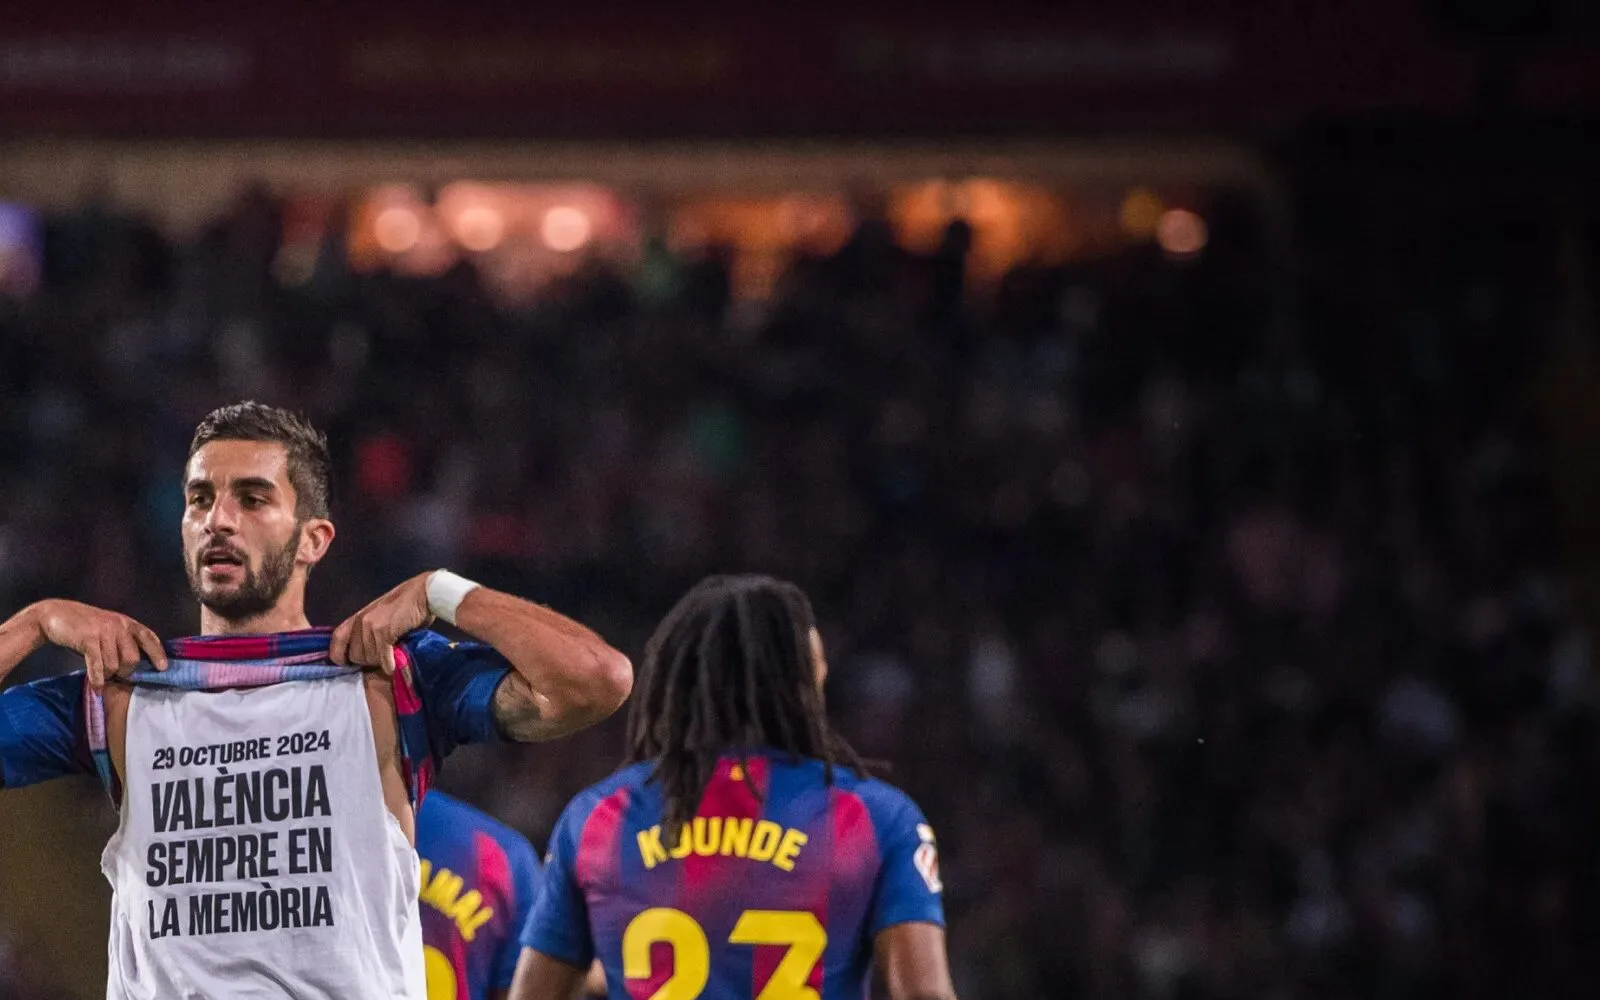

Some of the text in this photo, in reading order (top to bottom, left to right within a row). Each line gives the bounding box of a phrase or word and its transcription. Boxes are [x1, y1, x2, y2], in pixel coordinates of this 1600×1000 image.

[152, 729, 331, 770] 29 OCTUBRE 2024
[151, 764, 331, 832] VALÈNCIA
[146, 827, 332, 887] SEMPRE EN
[148, 882, 334, 939] LA MEMÒRIA
